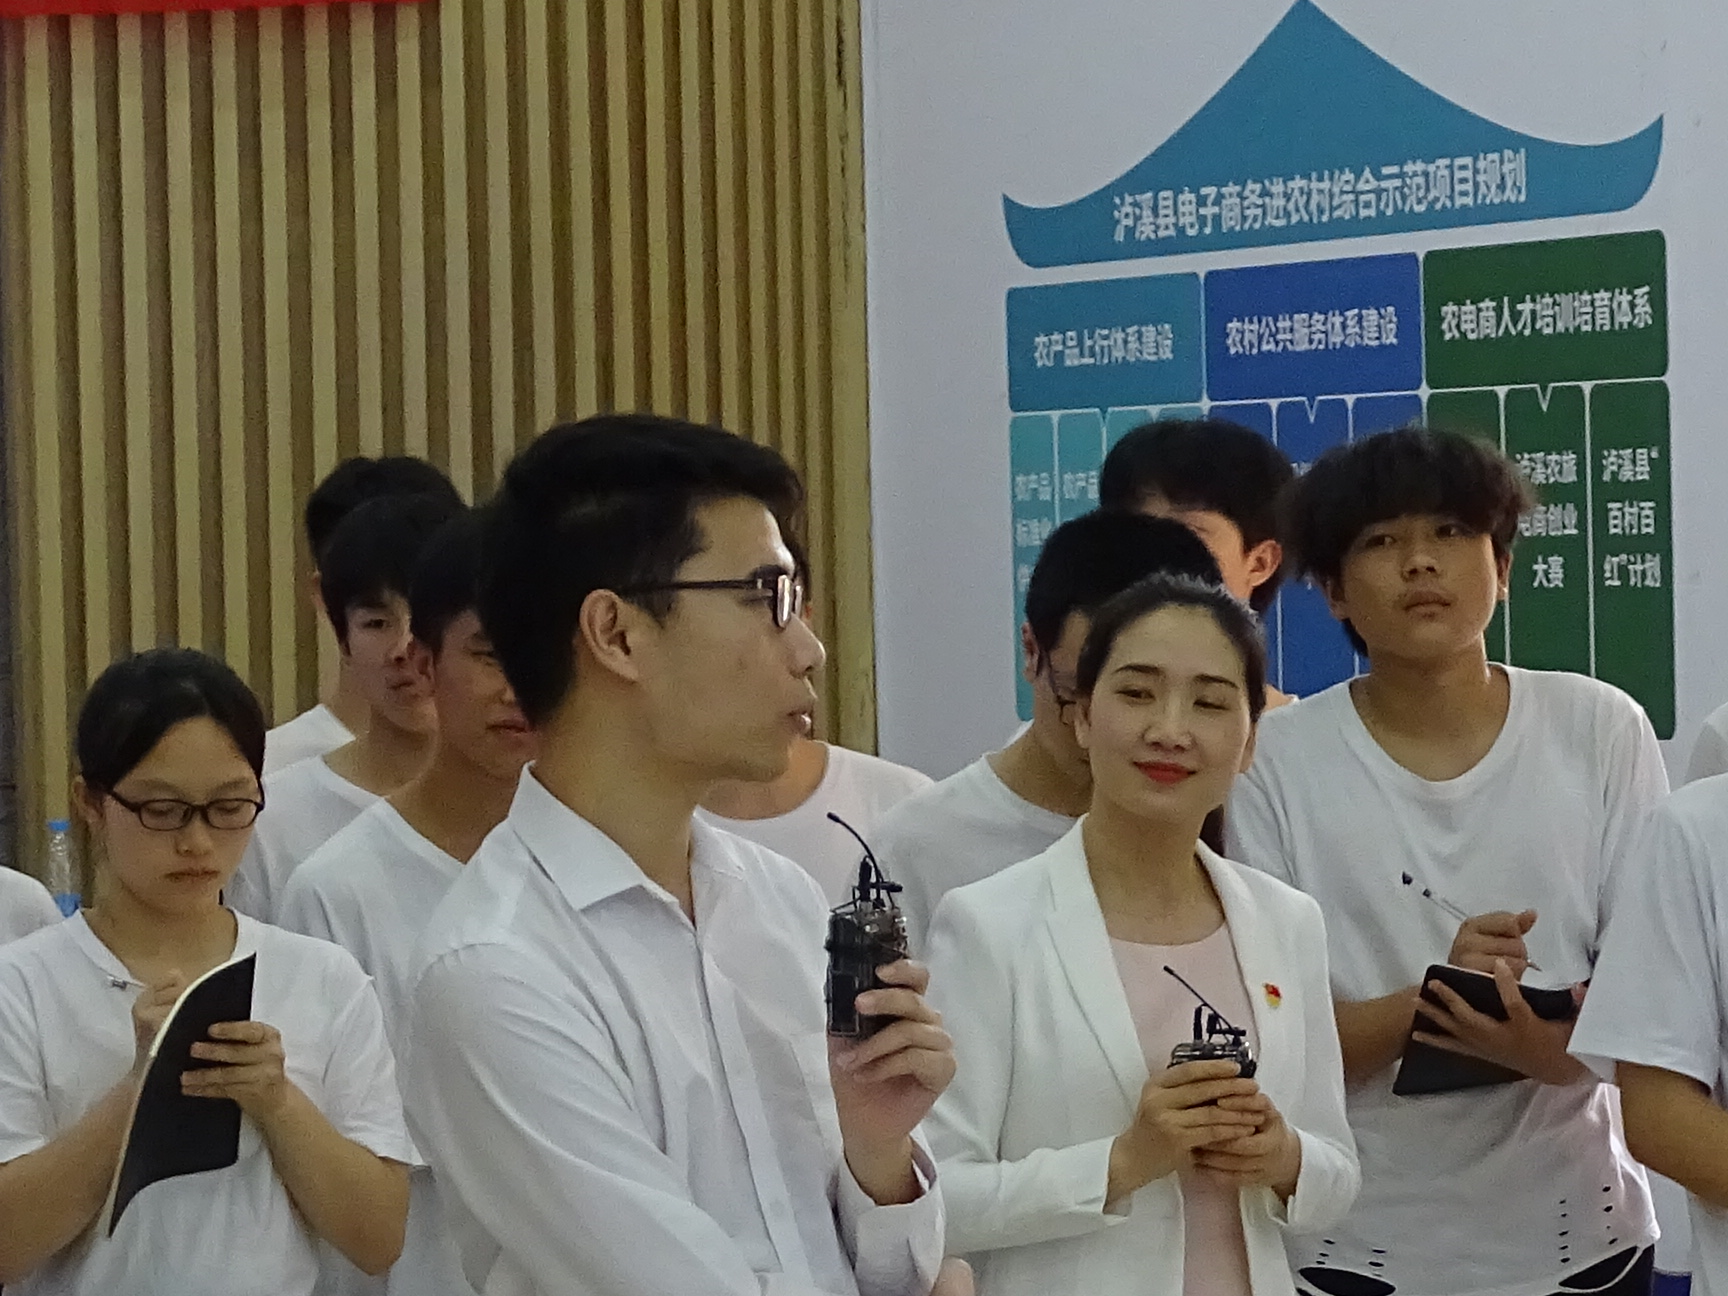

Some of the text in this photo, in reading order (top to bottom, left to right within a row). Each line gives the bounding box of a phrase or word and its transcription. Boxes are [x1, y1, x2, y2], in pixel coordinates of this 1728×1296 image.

[1113, 147, 1528, 243] 泸溪县电子商务进农村综合示范项目规划
[1033, 323, 1174, 369] 农产品上行体系建设
[1225, 306, 1398, 356] 农村公共服务体系建设
[1607, 500, 1657, 536] 百村百
[1532, 555, 1565, 589] 大赛
